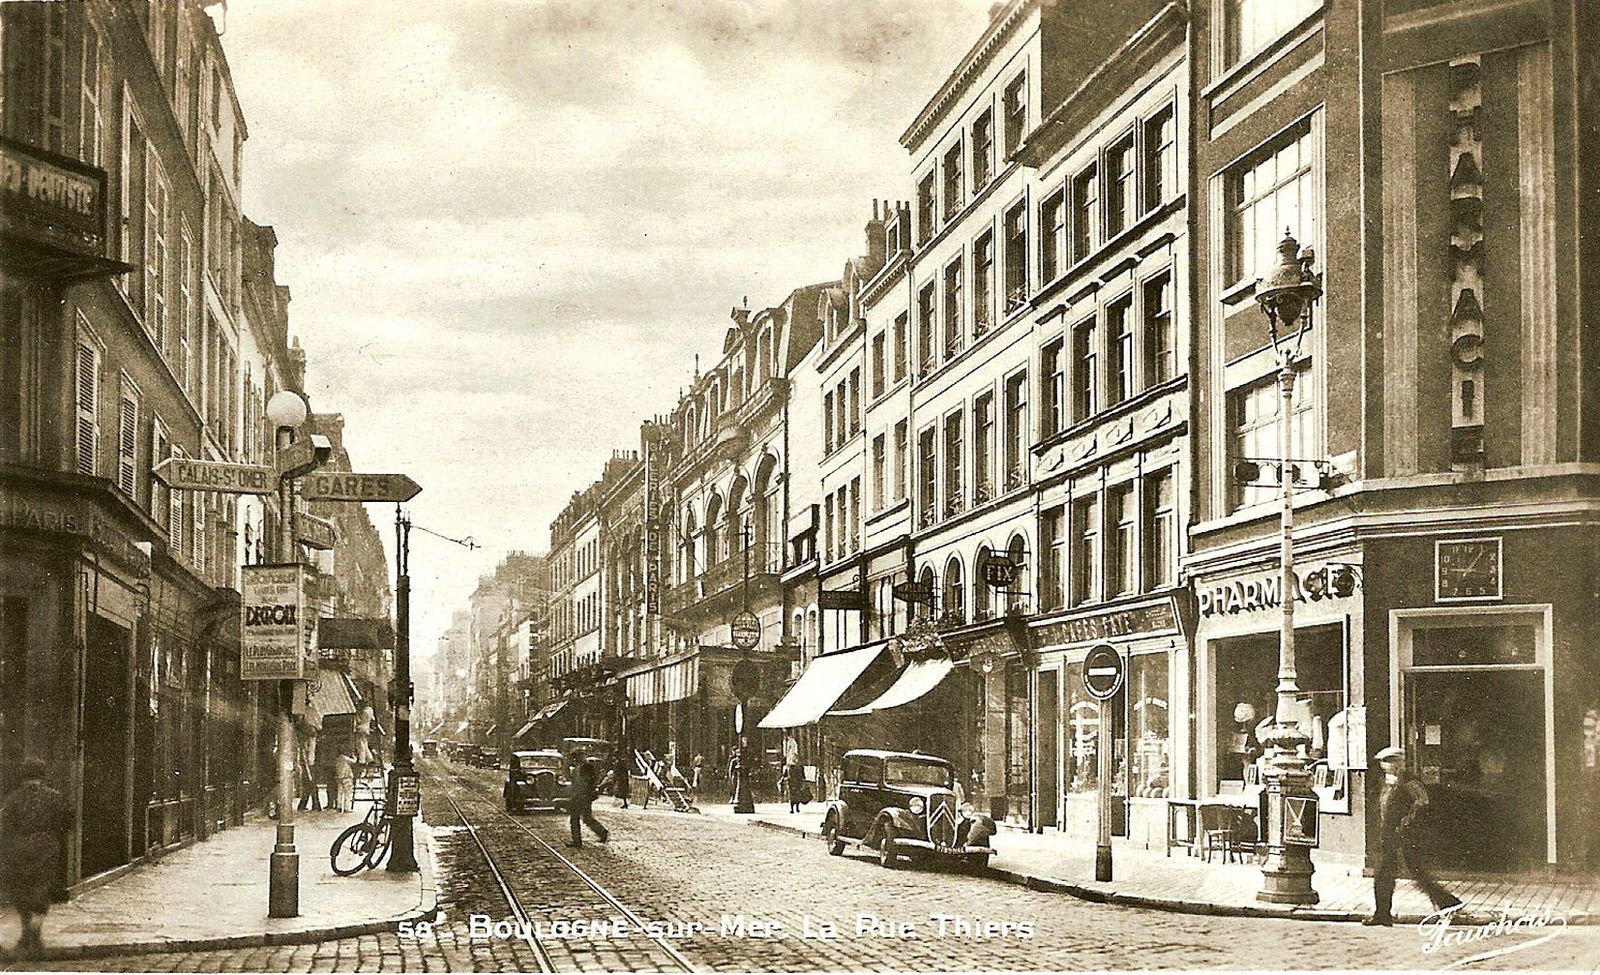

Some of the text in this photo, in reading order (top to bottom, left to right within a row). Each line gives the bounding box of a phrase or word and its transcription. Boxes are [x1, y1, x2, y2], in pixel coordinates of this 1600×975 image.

[316, 475, 390, 497] GARES
[649, 442, 659, 520] GALERIES
[649, 563, 659, 612] PARIS
[986, 565, 1012, 581] FIX
